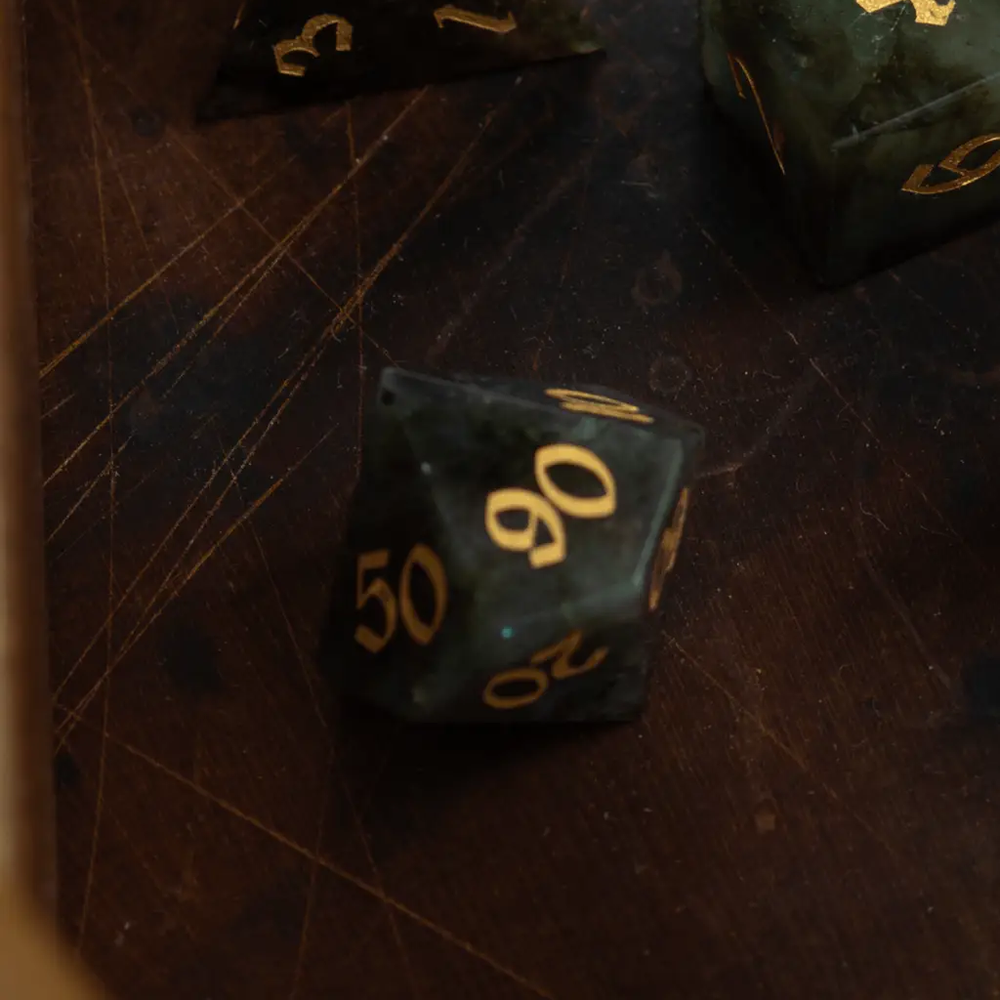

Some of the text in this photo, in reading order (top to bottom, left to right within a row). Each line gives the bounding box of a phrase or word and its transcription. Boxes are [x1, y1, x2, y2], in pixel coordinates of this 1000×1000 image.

[272, 12, 354, 78] 3
[433, 3, 518, 35] 1
[484, 442, 617, 569] 90
[353, 542, 450, 654] 50
[482, 629, 610, 709] 20
